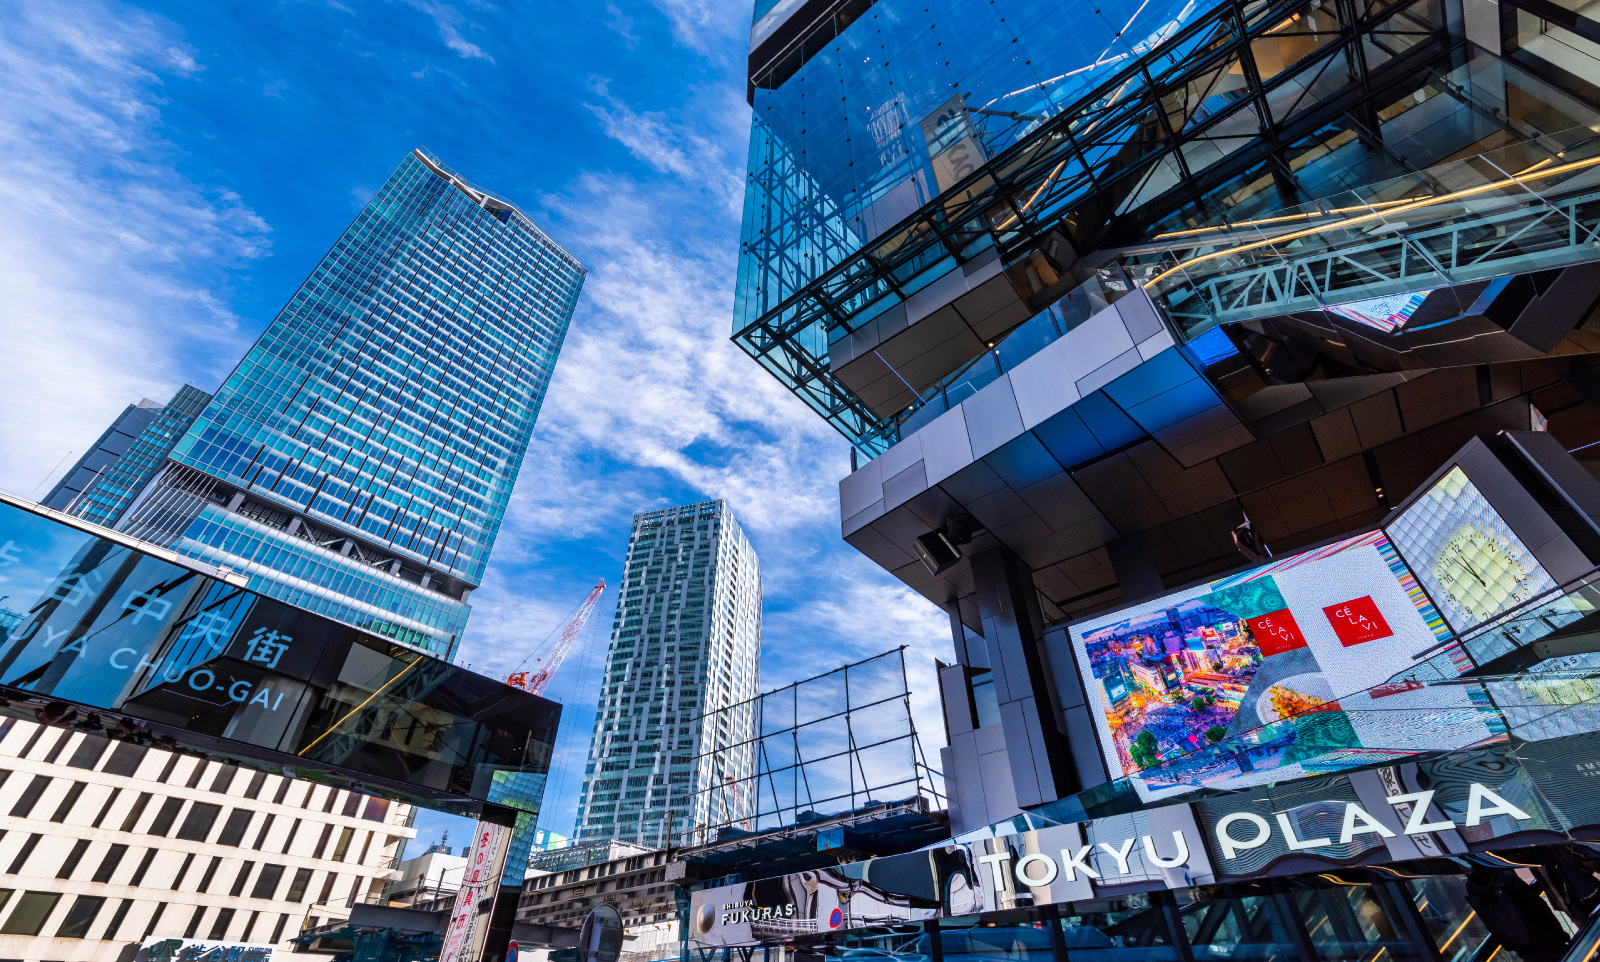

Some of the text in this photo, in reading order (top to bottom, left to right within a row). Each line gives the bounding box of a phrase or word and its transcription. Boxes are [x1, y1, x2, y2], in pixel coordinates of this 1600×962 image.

[1451, 544, 1463, 554] 12
[1488, 543, 1496, 553] 2
[1504, 555, 1513, 565] 3
[1443, 573, 1454, 584] 10
[1511, 592, 1521, 603] 5
[1335, 605, 1353, 618] CÉ
[1257, 617, 1274, 630] CÉ
[1348, 614, 1368, 625] LA
[1269, 626, 1287, 636] LA
[1361, 621, 1378, 631] VI
[1279, 632, 1295, 642] VI
[109, 647, 285, 711] CHUO-GAI
[979, 830, 1190, 892] TOKYU
[1215, 782, 1533, 860] PLAZA
[722, 900, 753, 911] SHIBUYA
[721, 903, 795, 926] FUKURAS
[148, 938, 184, 957] JR
